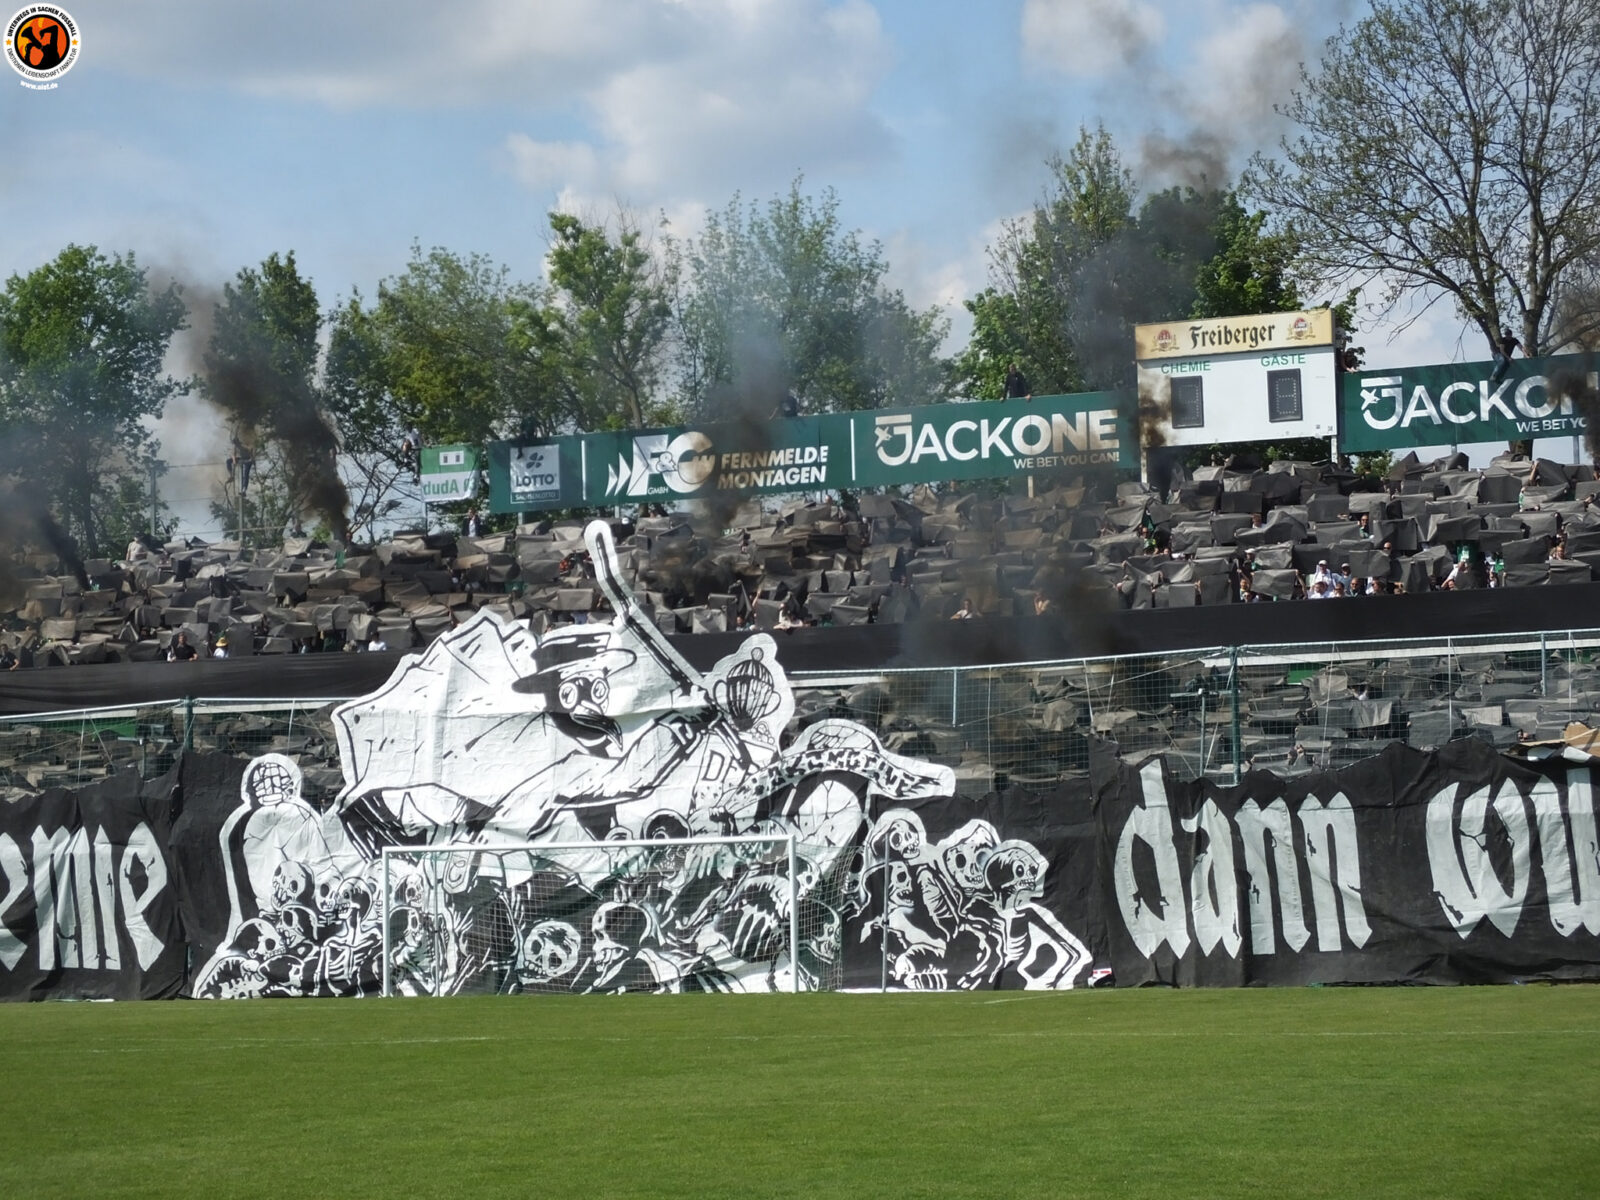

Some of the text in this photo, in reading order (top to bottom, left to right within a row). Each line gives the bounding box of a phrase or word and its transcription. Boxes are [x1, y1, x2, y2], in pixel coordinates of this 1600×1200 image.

[1189, 324, 1276, 349] Freiberger
[1161, 360, 1211, 374] CHEMIE
[1260, 353, 1306, 367] GÄSTE
[1516, 420, 1540, 433] WE
[1542, 418, 1568, 431] BET
[875, 409, 1120, 466] JACKONE
[721, 445, 829, 469] FERNMELDE
[1013, 451, 1120, 469] WE BET YOU CAN!
[515, 473, 555, 487] LOTTO
[717, 465, 827, 489] MONTAGEN
